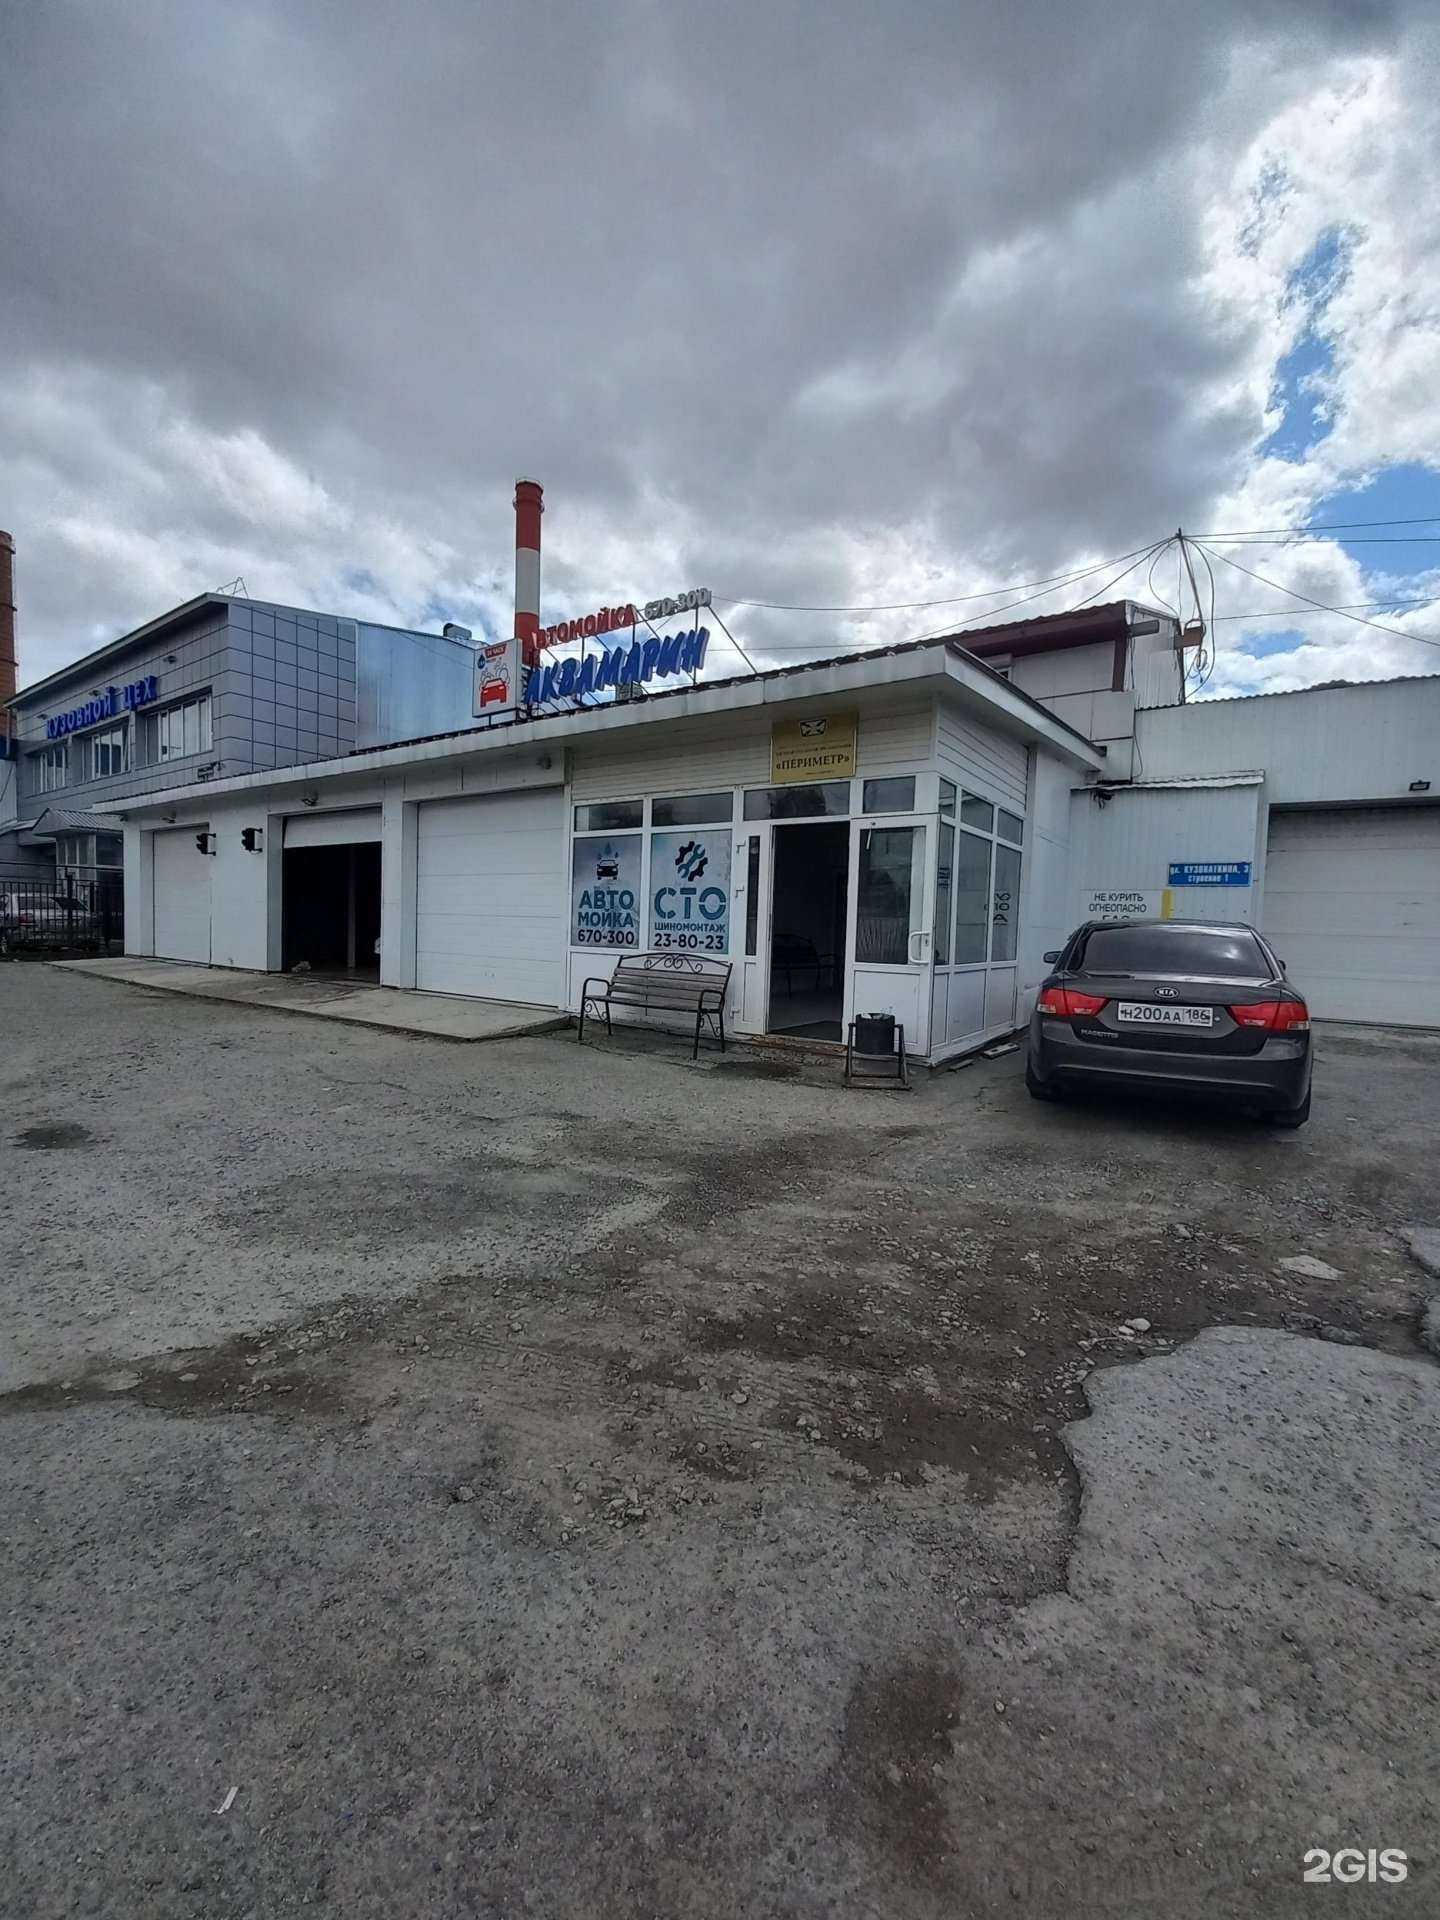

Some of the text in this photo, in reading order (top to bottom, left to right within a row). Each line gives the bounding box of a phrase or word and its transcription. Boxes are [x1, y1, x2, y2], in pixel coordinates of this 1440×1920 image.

[531, 604, 639, 649] ВТОМОЙКА
[523, 626, 710, 705] АКВАМАРИН
[47, 676, 158, 739] КУЗОВНОЙ ЦЕХ
[776, 754, 850, 769] «ПЕРИМЕТР»
[579, 890, 634, 910] АВТО
[654, 887, 727, 920] СТО
[1094, 893, 1144, 902] НЕ КУРИТЬ
[1088, 903, 1147, 913] ОГНЕОПАСНО
[577, 909, 634, 928] МОЙКА
[654, 922, 726, 933] ШИНОМОНТАЖ
[577, 929, 635, 945] 670-300
[653, 933, 724, 950] 23-80-23
[1158, 989, 1175, 998] KIA
